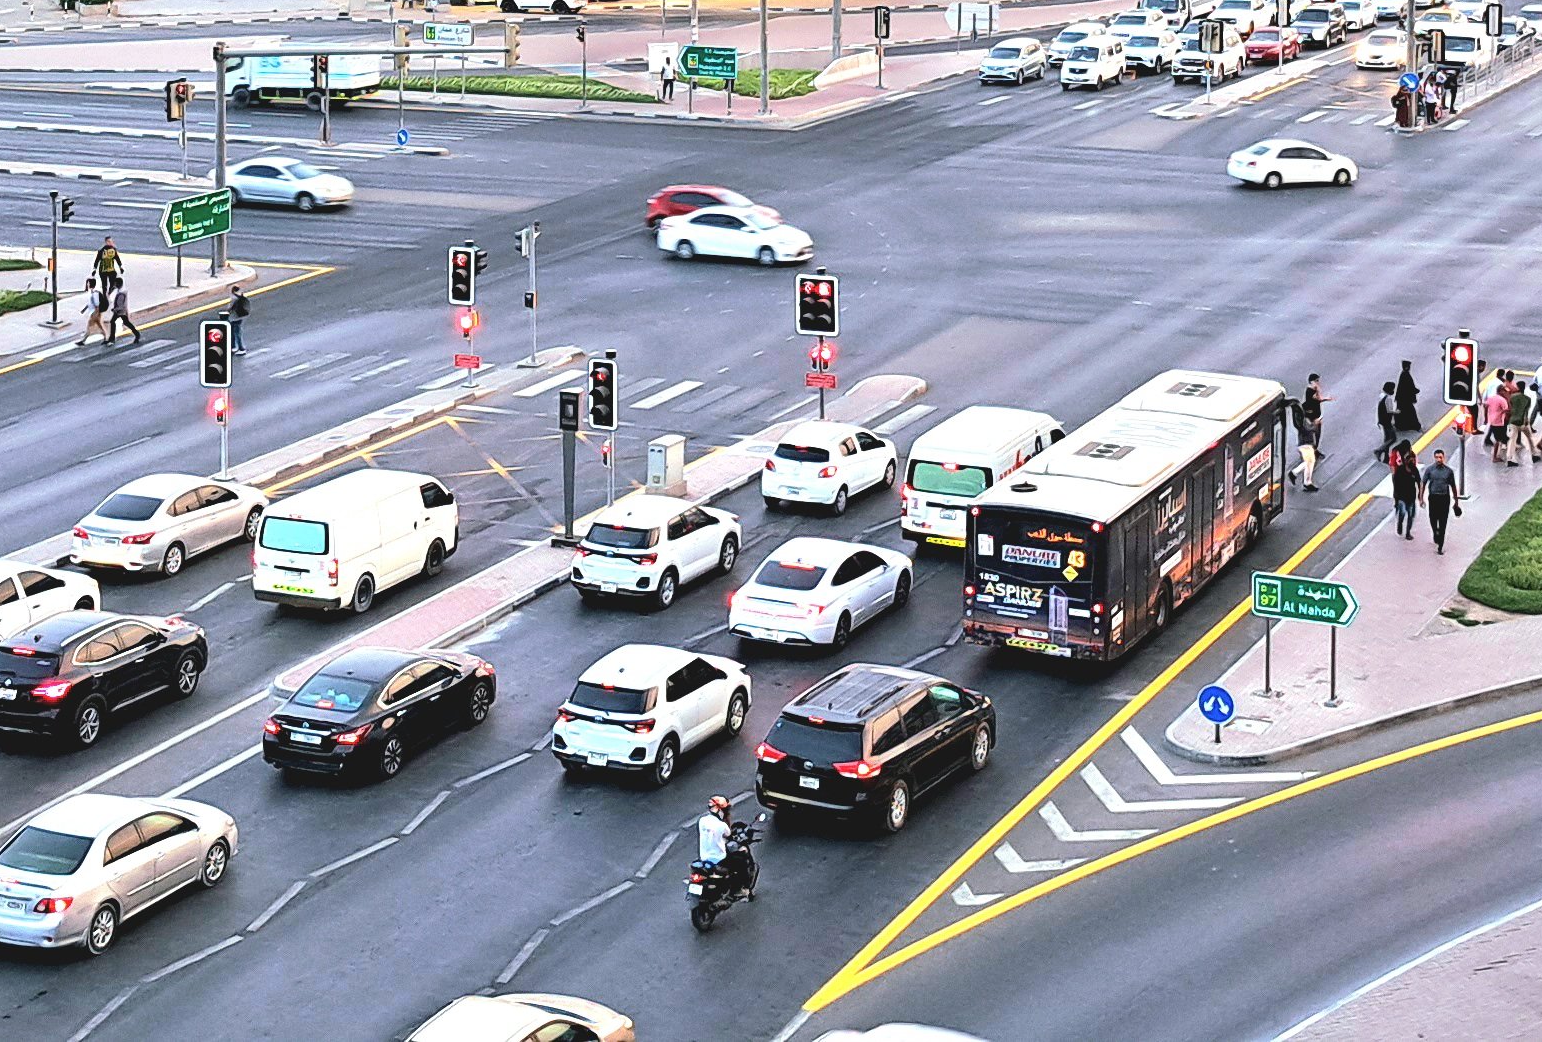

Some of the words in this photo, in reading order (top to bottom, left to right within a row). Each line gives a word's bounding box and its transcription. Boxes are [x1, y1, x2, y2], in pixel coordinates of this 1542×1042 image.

[1005, 547, 1058, 560] DANUBE
[1067, 550, 1085, 568] 43
[984, 581, 1044, 603] ASPIRZ
[1260, 594, 1277, 606] 97
[1283, 601, 1295, 613] Al
[1298, 603, 1336, 618] Nahda
